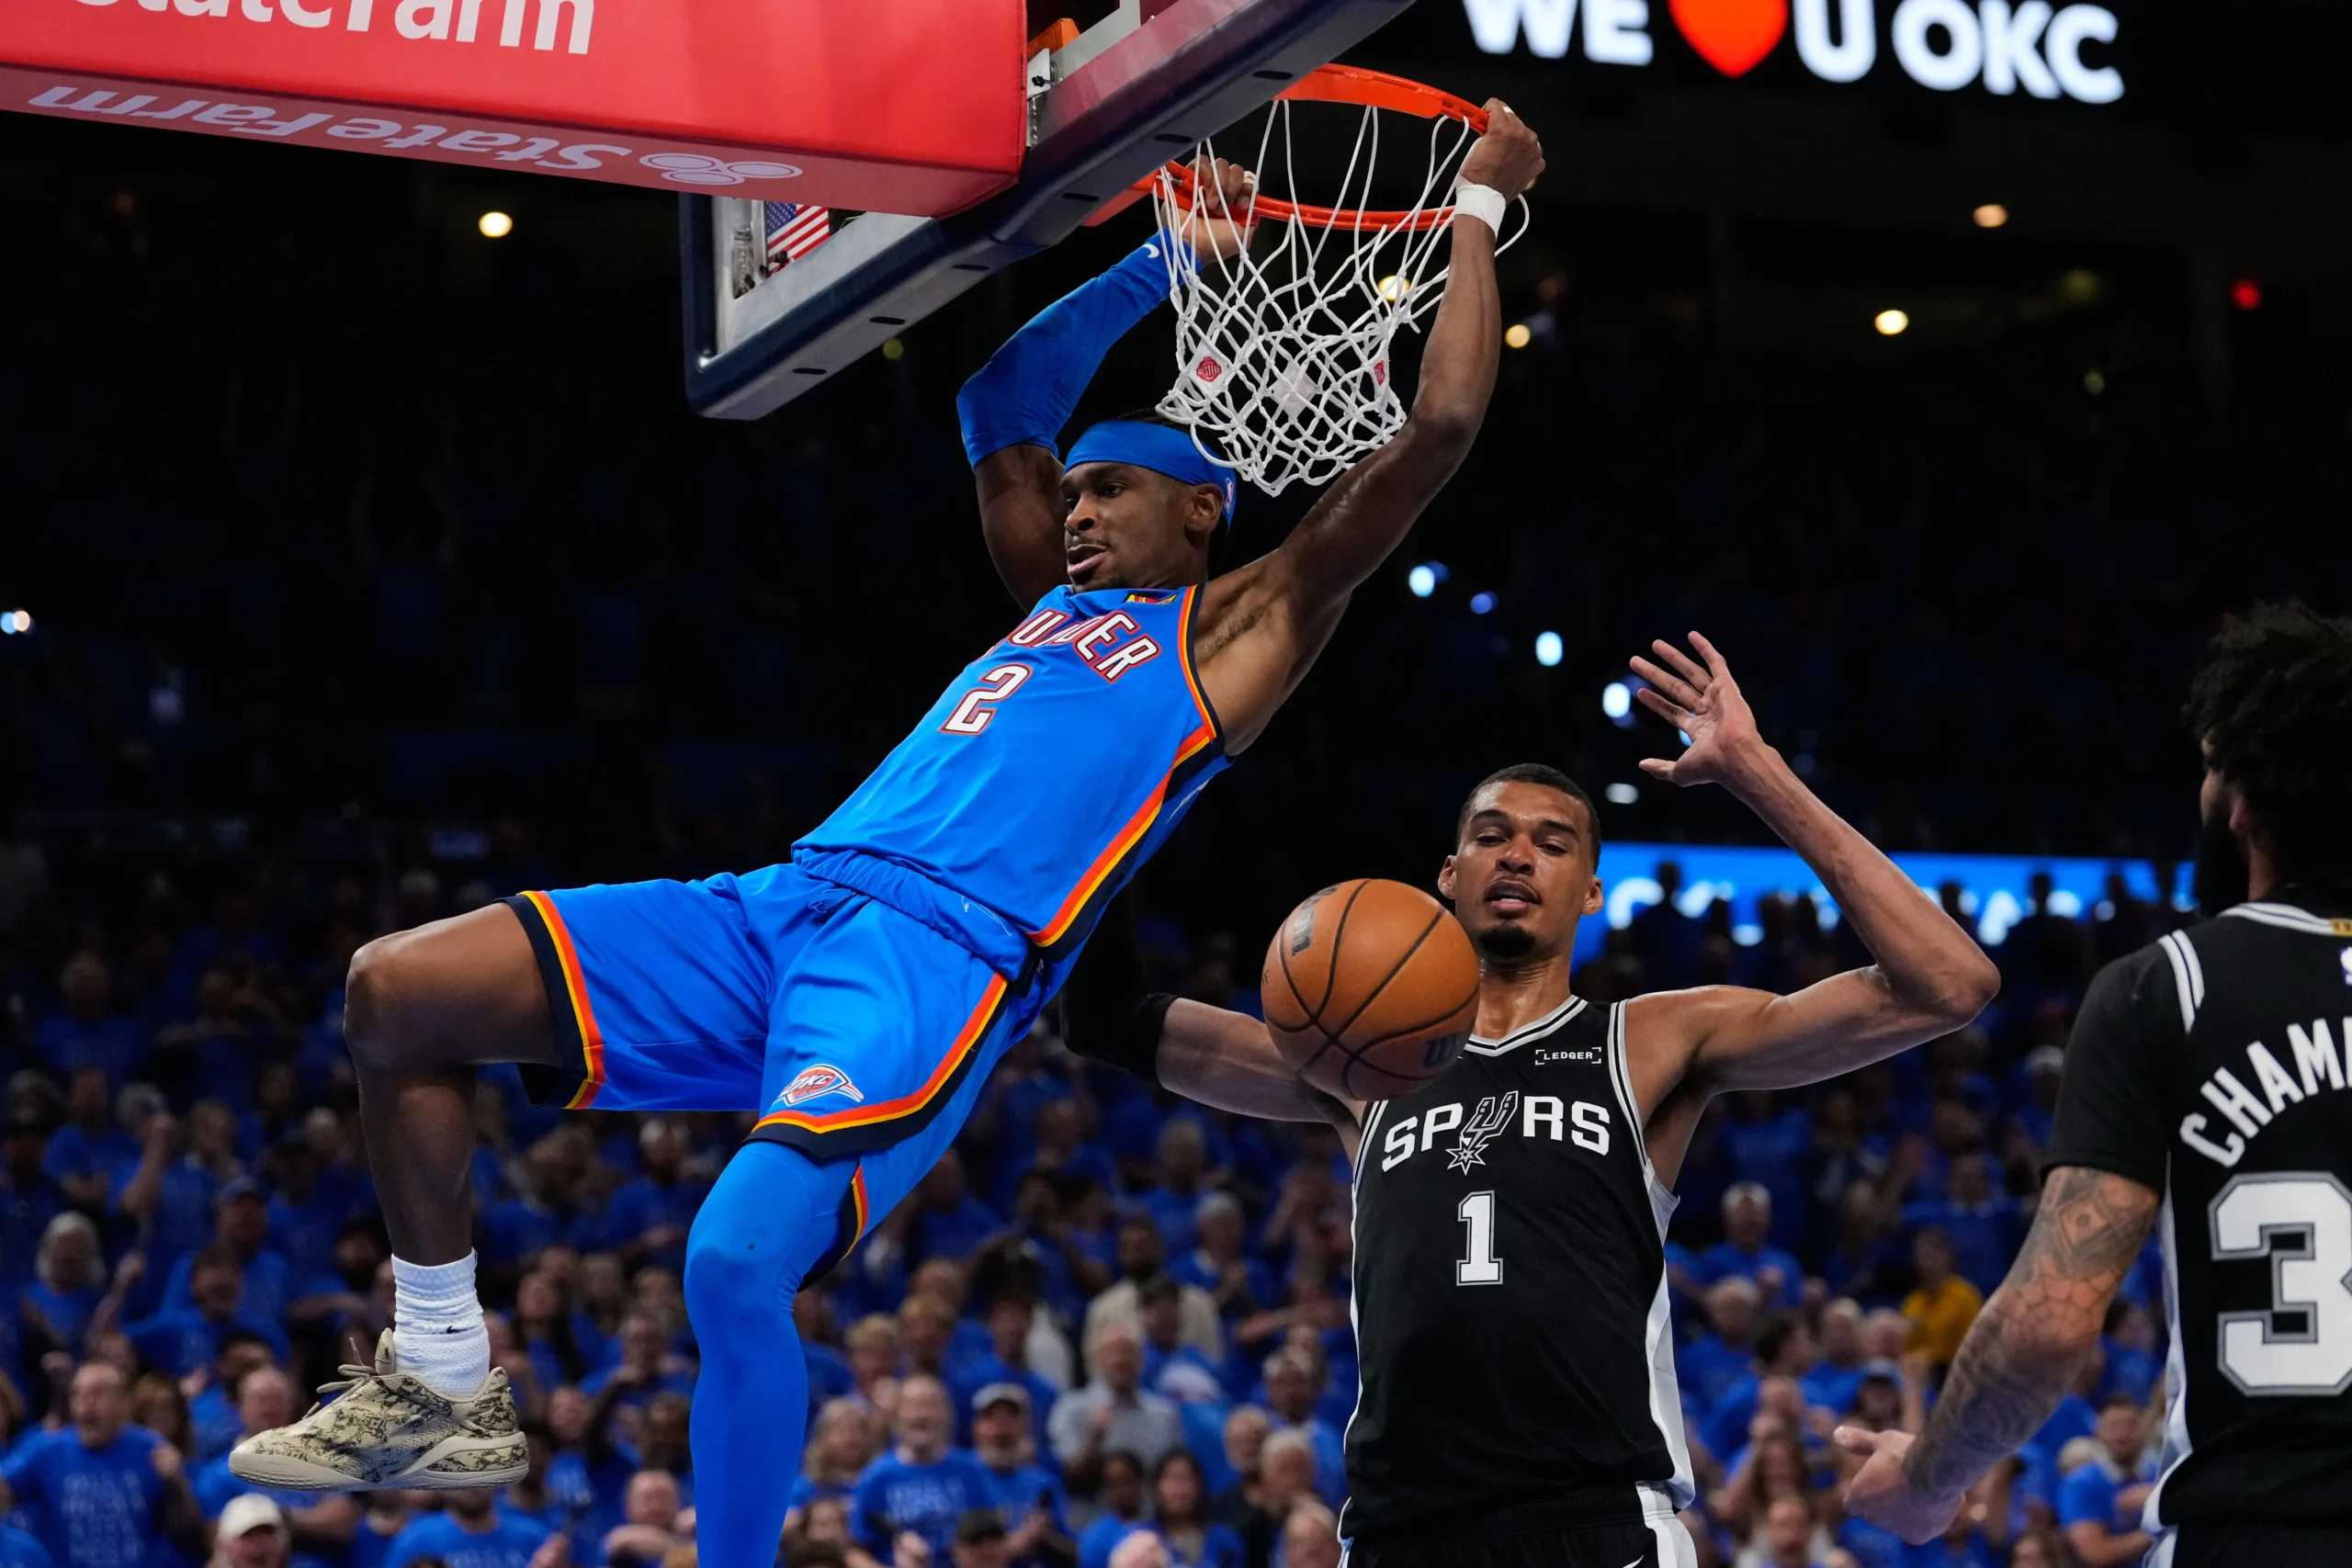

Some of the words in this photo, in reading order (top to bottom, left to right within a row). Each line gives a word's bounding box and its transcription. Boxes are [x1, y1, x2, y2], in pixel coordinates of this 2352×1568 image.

[1463, 0, 1652, 65] WE
[1792, 0, 1876, 83] U
[1892, 0, 2124, 104] OKC
[28, 85, 334, 137] Farm
[326, 118, 633, 170] State
[938, 662, 1033, 735] 2
[1544, 1051, 1593, 1060] LEDGER
[1382, 1090, 1610, 1175] SPURS
[1456, 1190, 1503, 1286] 1
[2207, 1171, 2352, 1396] 3
